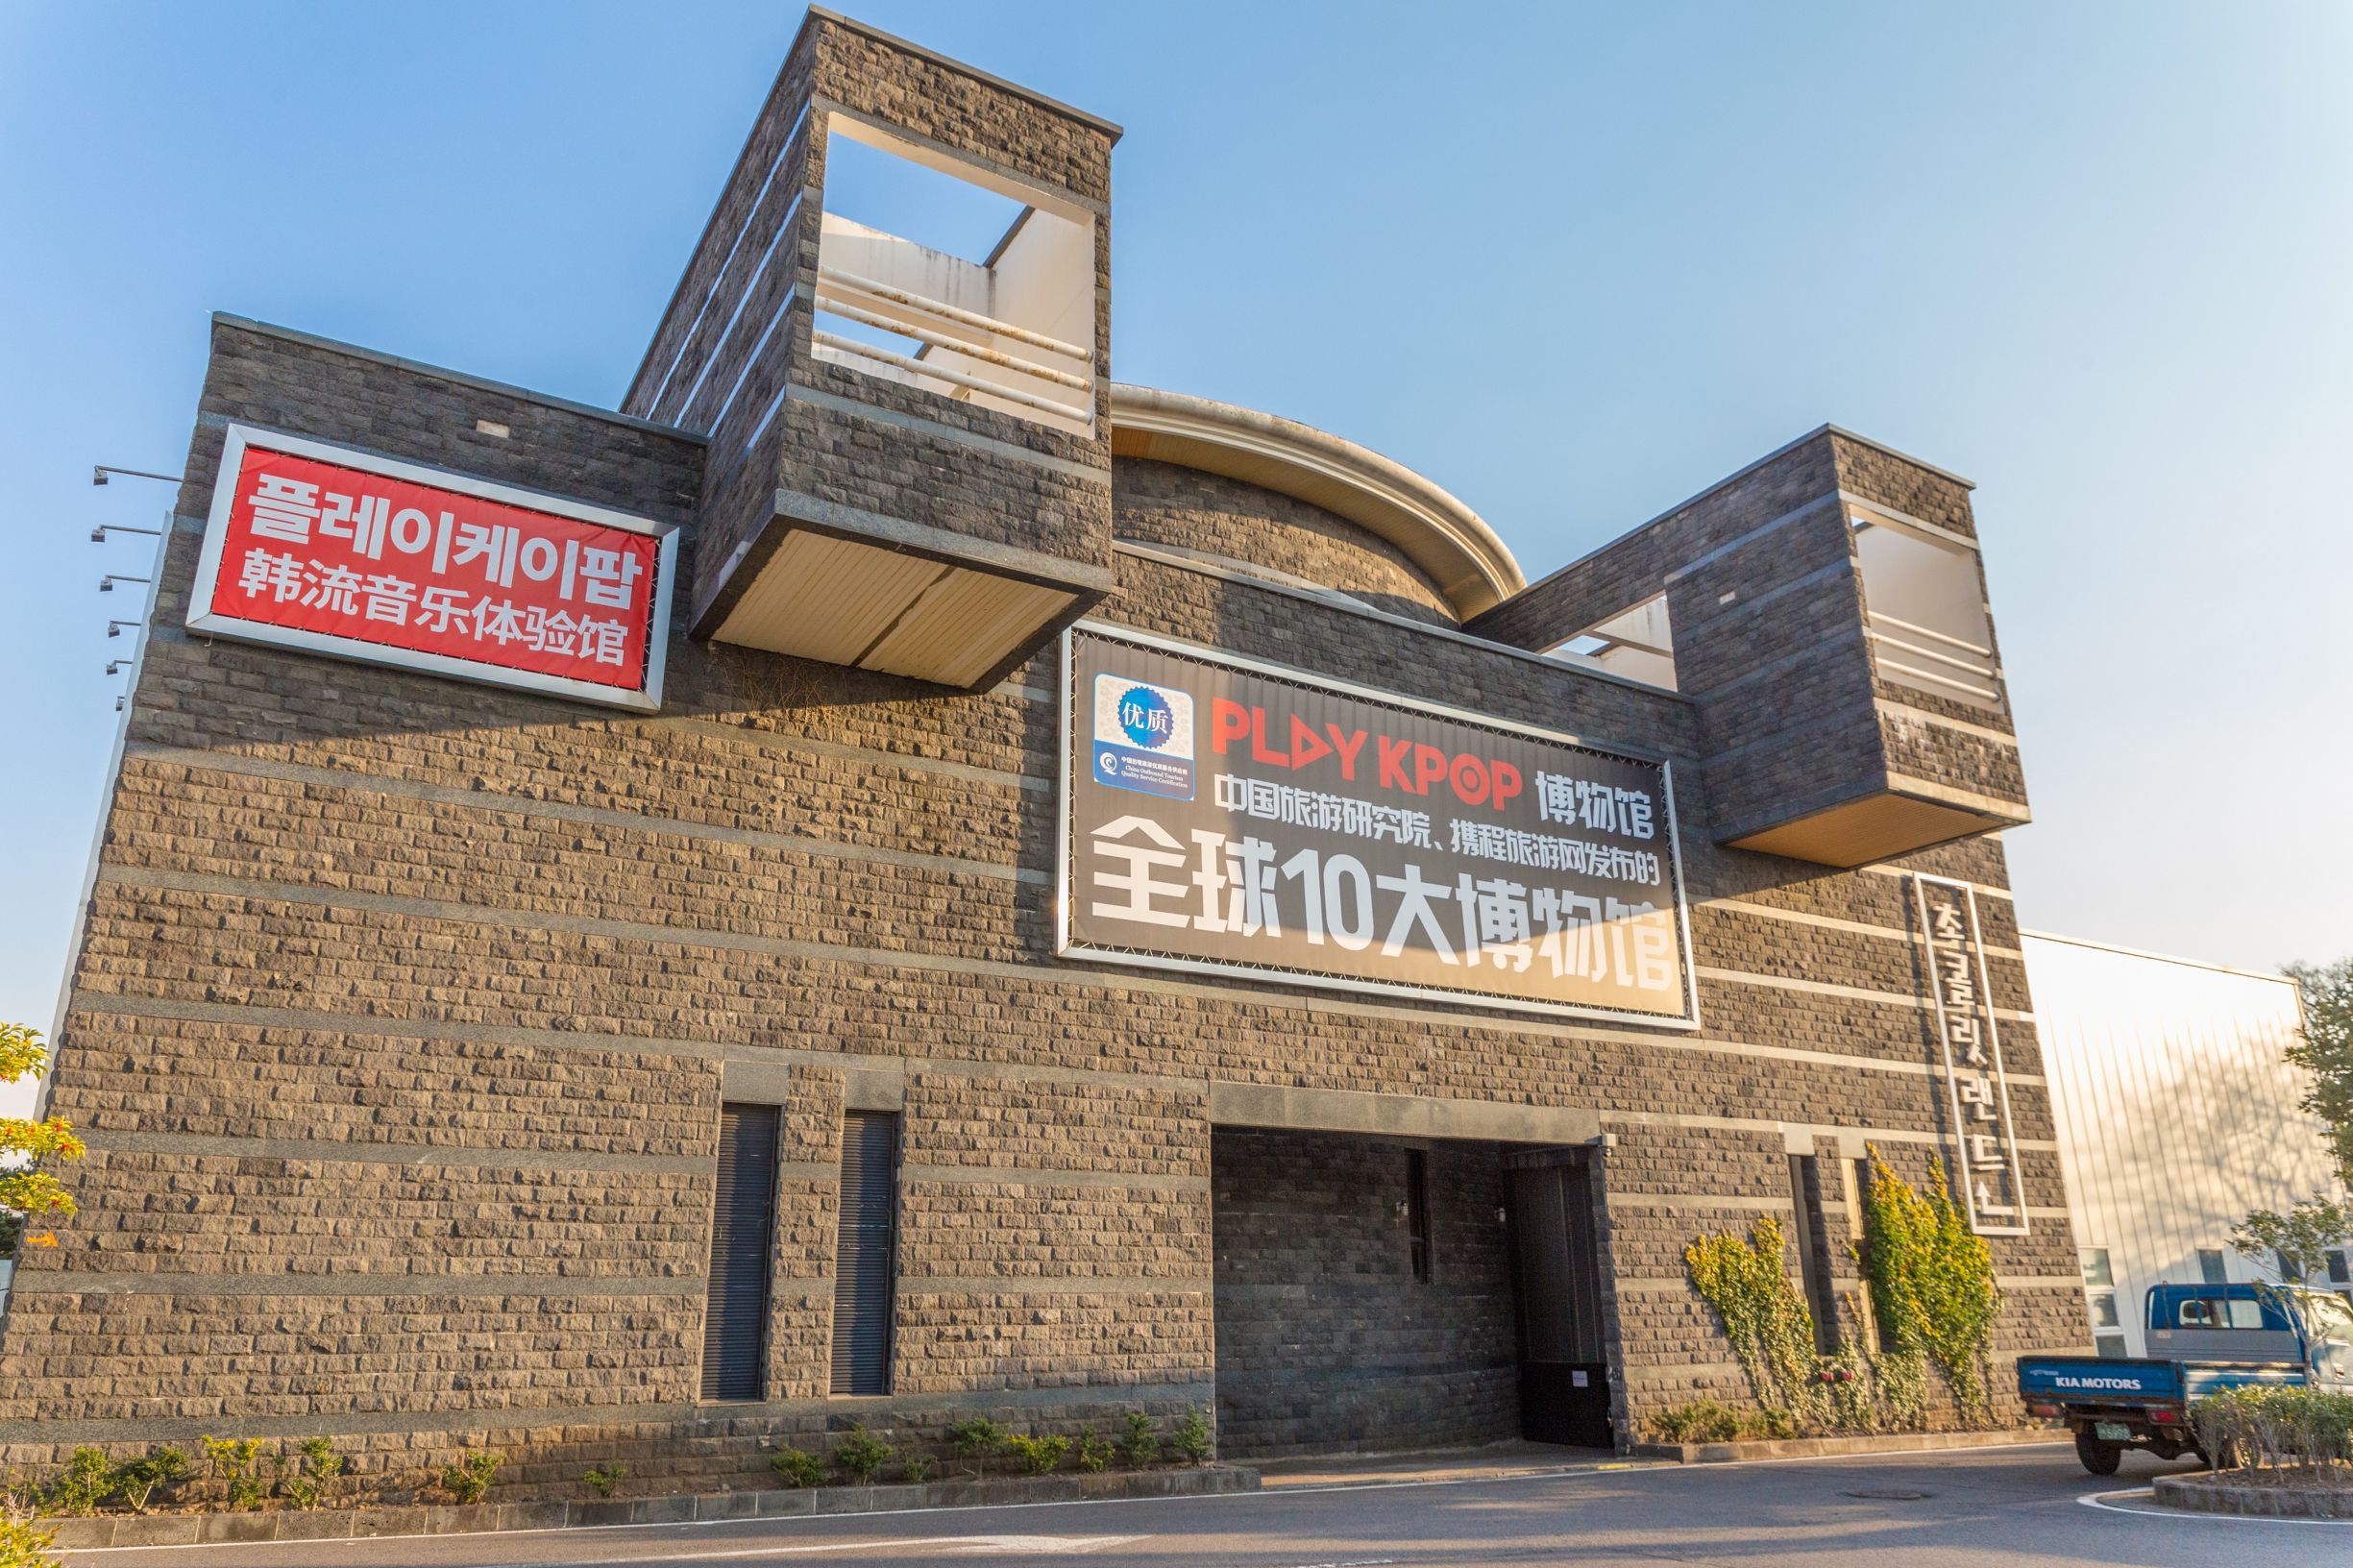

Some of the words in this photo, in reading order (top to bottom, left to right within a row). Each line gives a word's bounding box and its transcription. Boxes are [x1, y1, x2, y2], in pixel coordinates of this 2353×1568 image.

[249, 473, 643, 610] 플레이케이팝
[238, 548, 629, 667] 韩流音乐体验馆
[1122, 700, 1169, 735] 优质
[1125, 765, 1140, 773] China
[1213, 697, 1369, 781] PLAY
[1378, 735, 1523, 811] KPOP
[1535, 770, 1655, 841] 博物馆
[1121, 771, 1140, 779] Quality
[1140, 773, 1158, 782] Service
[1213, 772, 1661, 887] 中国旅游研究院、携程旅游网发布的
[1090, 815, 1673, 992] 全球10大博物馆
[1932, 902, 2006, 1171] 초콜릿랜드
[2055, 1377, 2081, 1388] KIA
[2081, 1377, 2142, 1390] MOTORS
